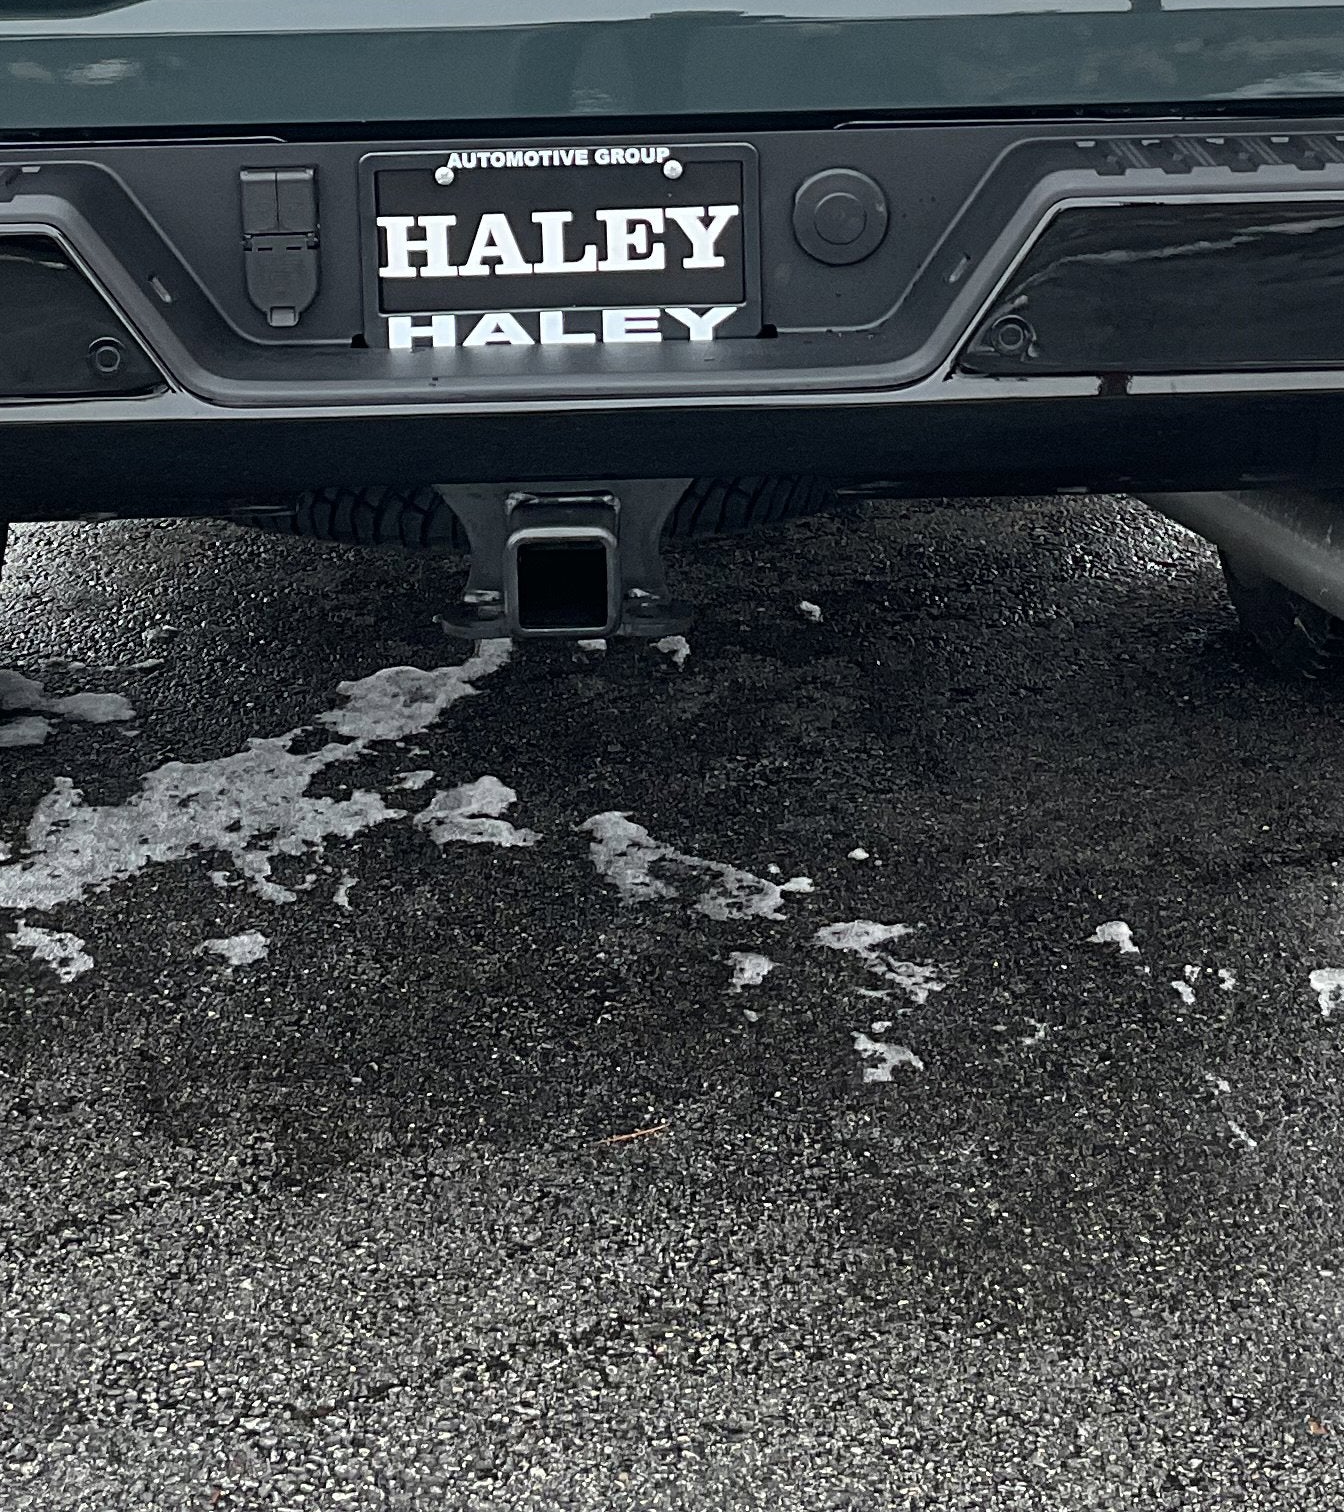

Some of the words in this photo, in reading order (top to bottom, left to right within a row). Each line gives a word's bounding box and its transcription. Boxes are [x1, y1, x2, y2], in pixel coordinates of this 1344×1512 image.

[446, 148, 589, 170] AUTOMOTIVE
[594, 147, 670, 166] GROUP
[376, 204, 739, 278] HALEY
[388, 306, 738, 350] HALEY
